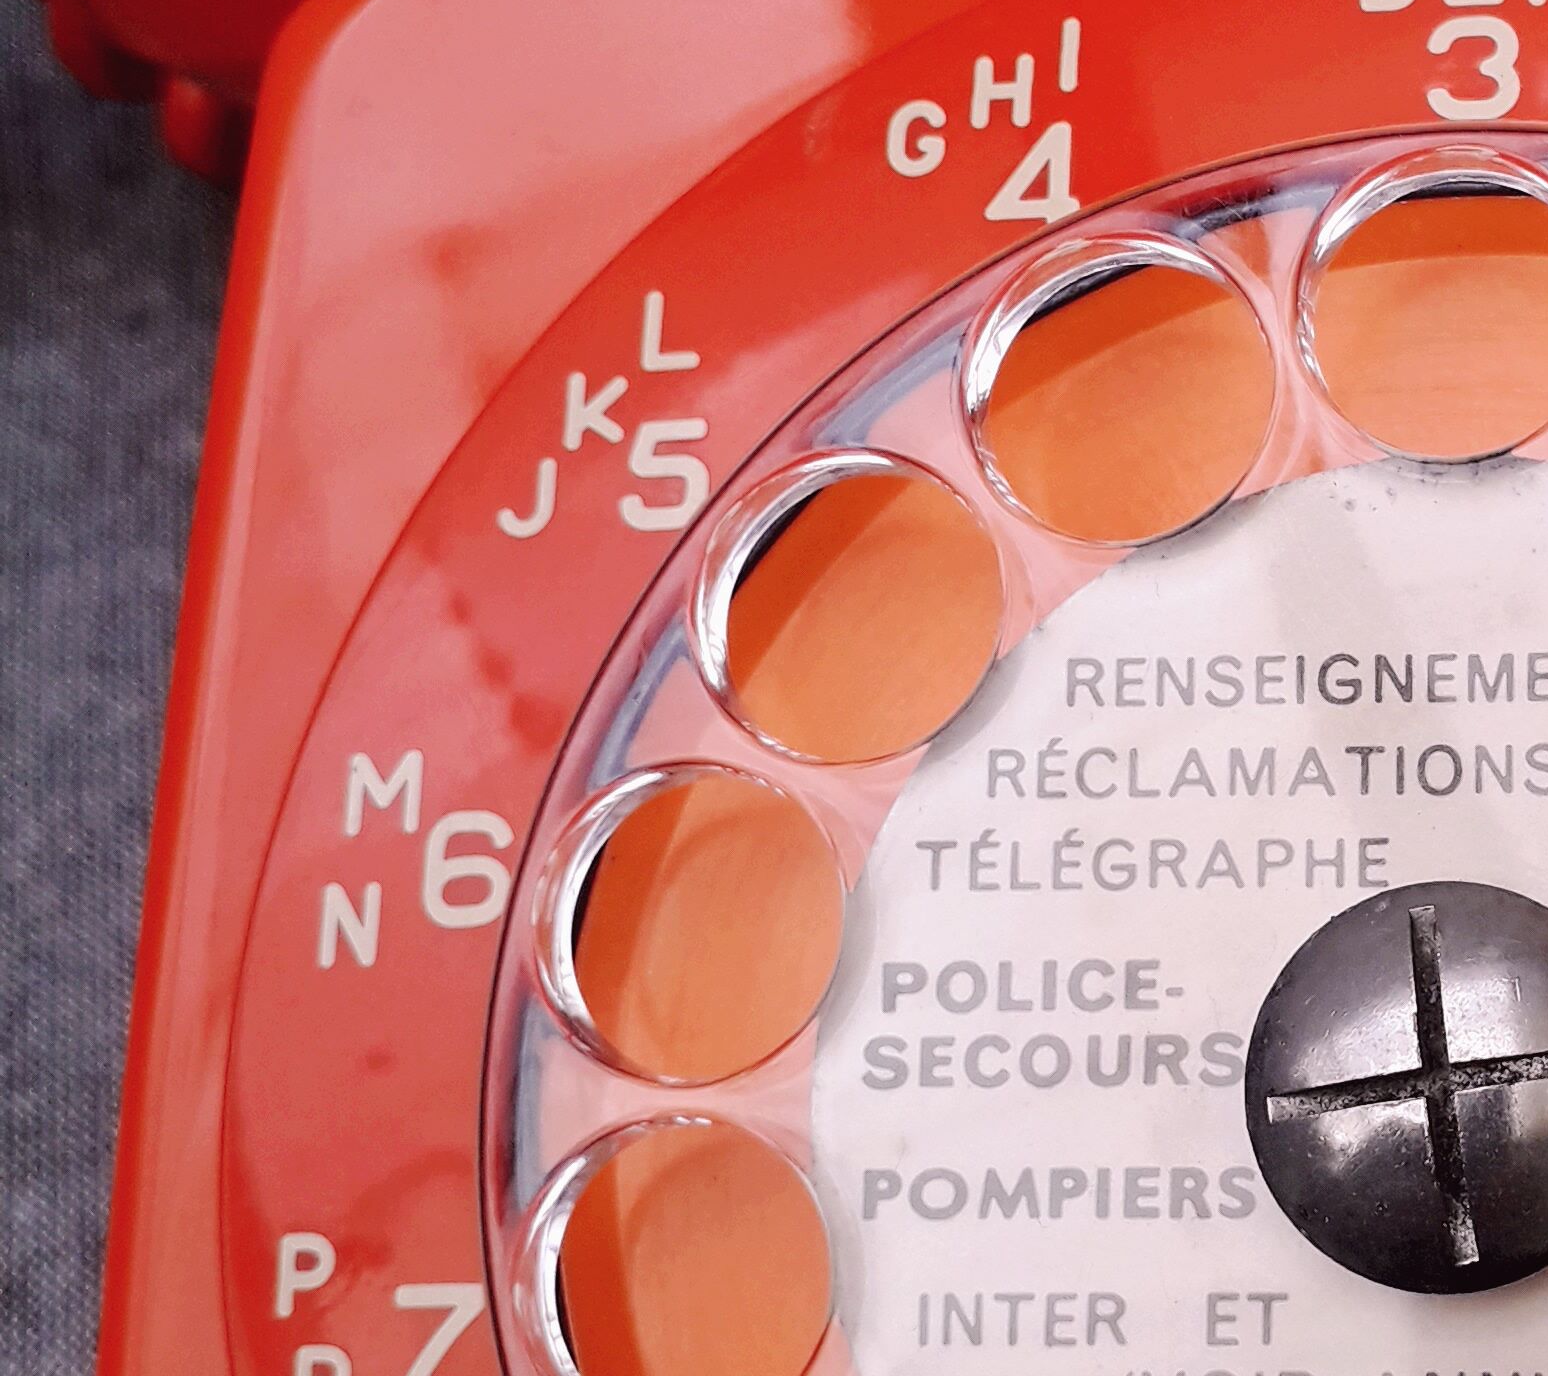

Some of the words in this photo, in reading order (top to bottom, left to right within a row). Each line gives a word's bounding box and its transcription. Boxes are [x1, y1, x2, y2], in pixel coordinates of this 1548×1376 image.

[1426, 16, 1522, 121] 3
[983, 121, 1081, 222] 4
[618, 418, 712, 532] 5
[421, 808, 515, 929] 6
[916, 832, 1391, 893] TÉLÉGRAPHE
[881, 959, 1185, 1015] POLICE-
[861, 1034, 1248, 1091] SECOURS
[861, 1165, 1258, 1221] POMPIERS
[916, 1291, 1126, 1349] INTER
[1207, 1291, 1289, 1347] ET
